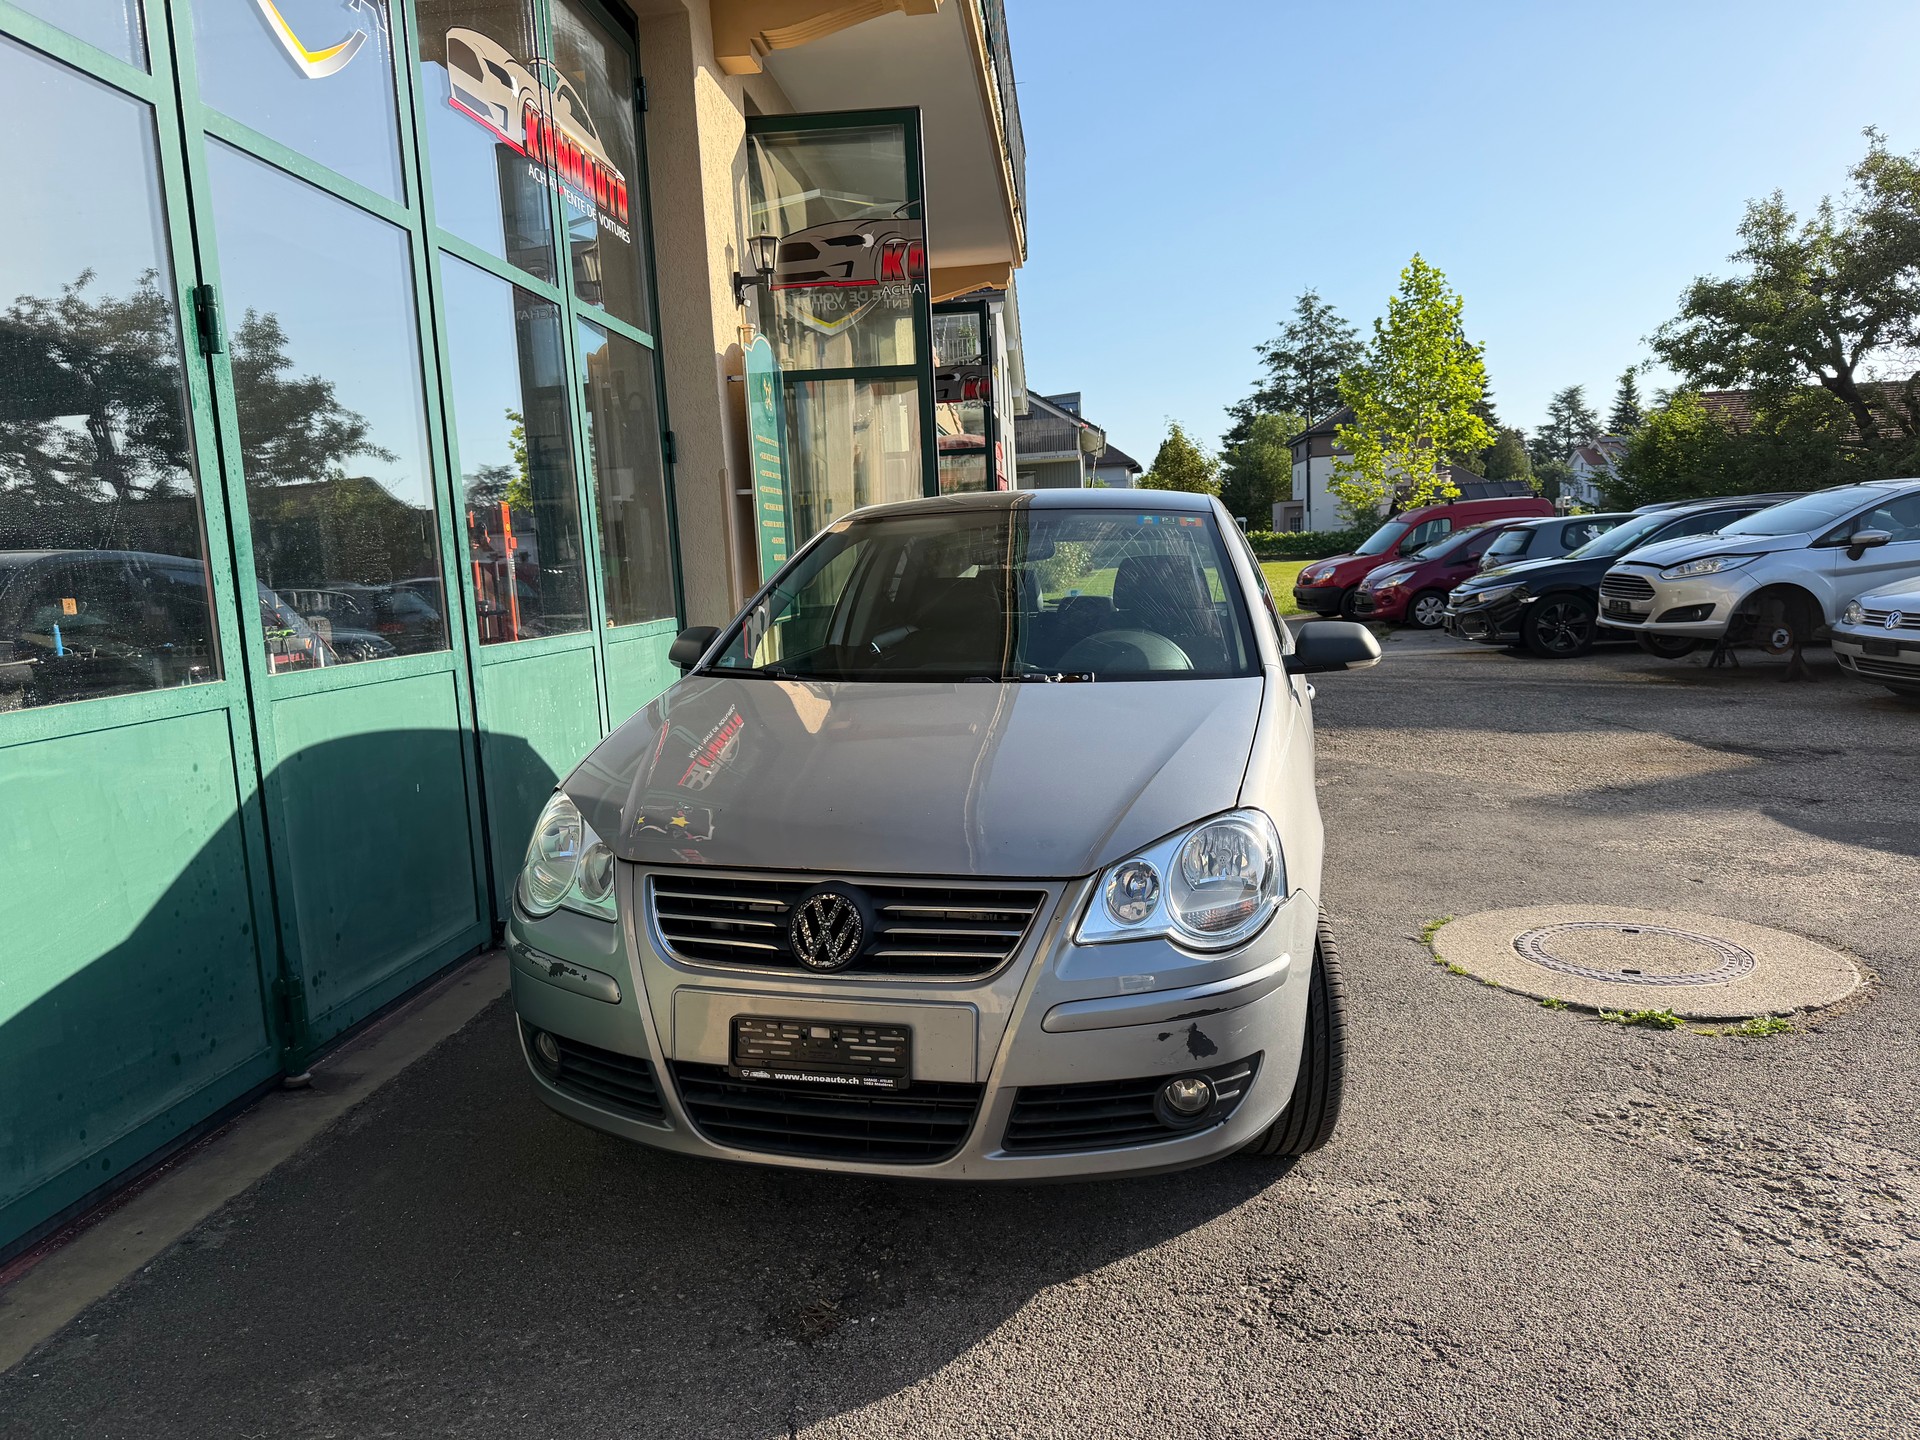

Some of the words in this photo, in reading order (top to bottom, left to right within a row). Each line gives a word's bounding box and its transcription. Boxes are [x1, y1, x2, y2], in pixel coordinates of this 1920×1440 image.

[525, 102, 629, 225] KONOAUTO
[528, 163, 558, 192] ACHAT
[586, 203, 598, 221] DE
[598, 211, 631, 244] VOITURES
[774, 1072, 860, 1085] www.konoauto.ch
